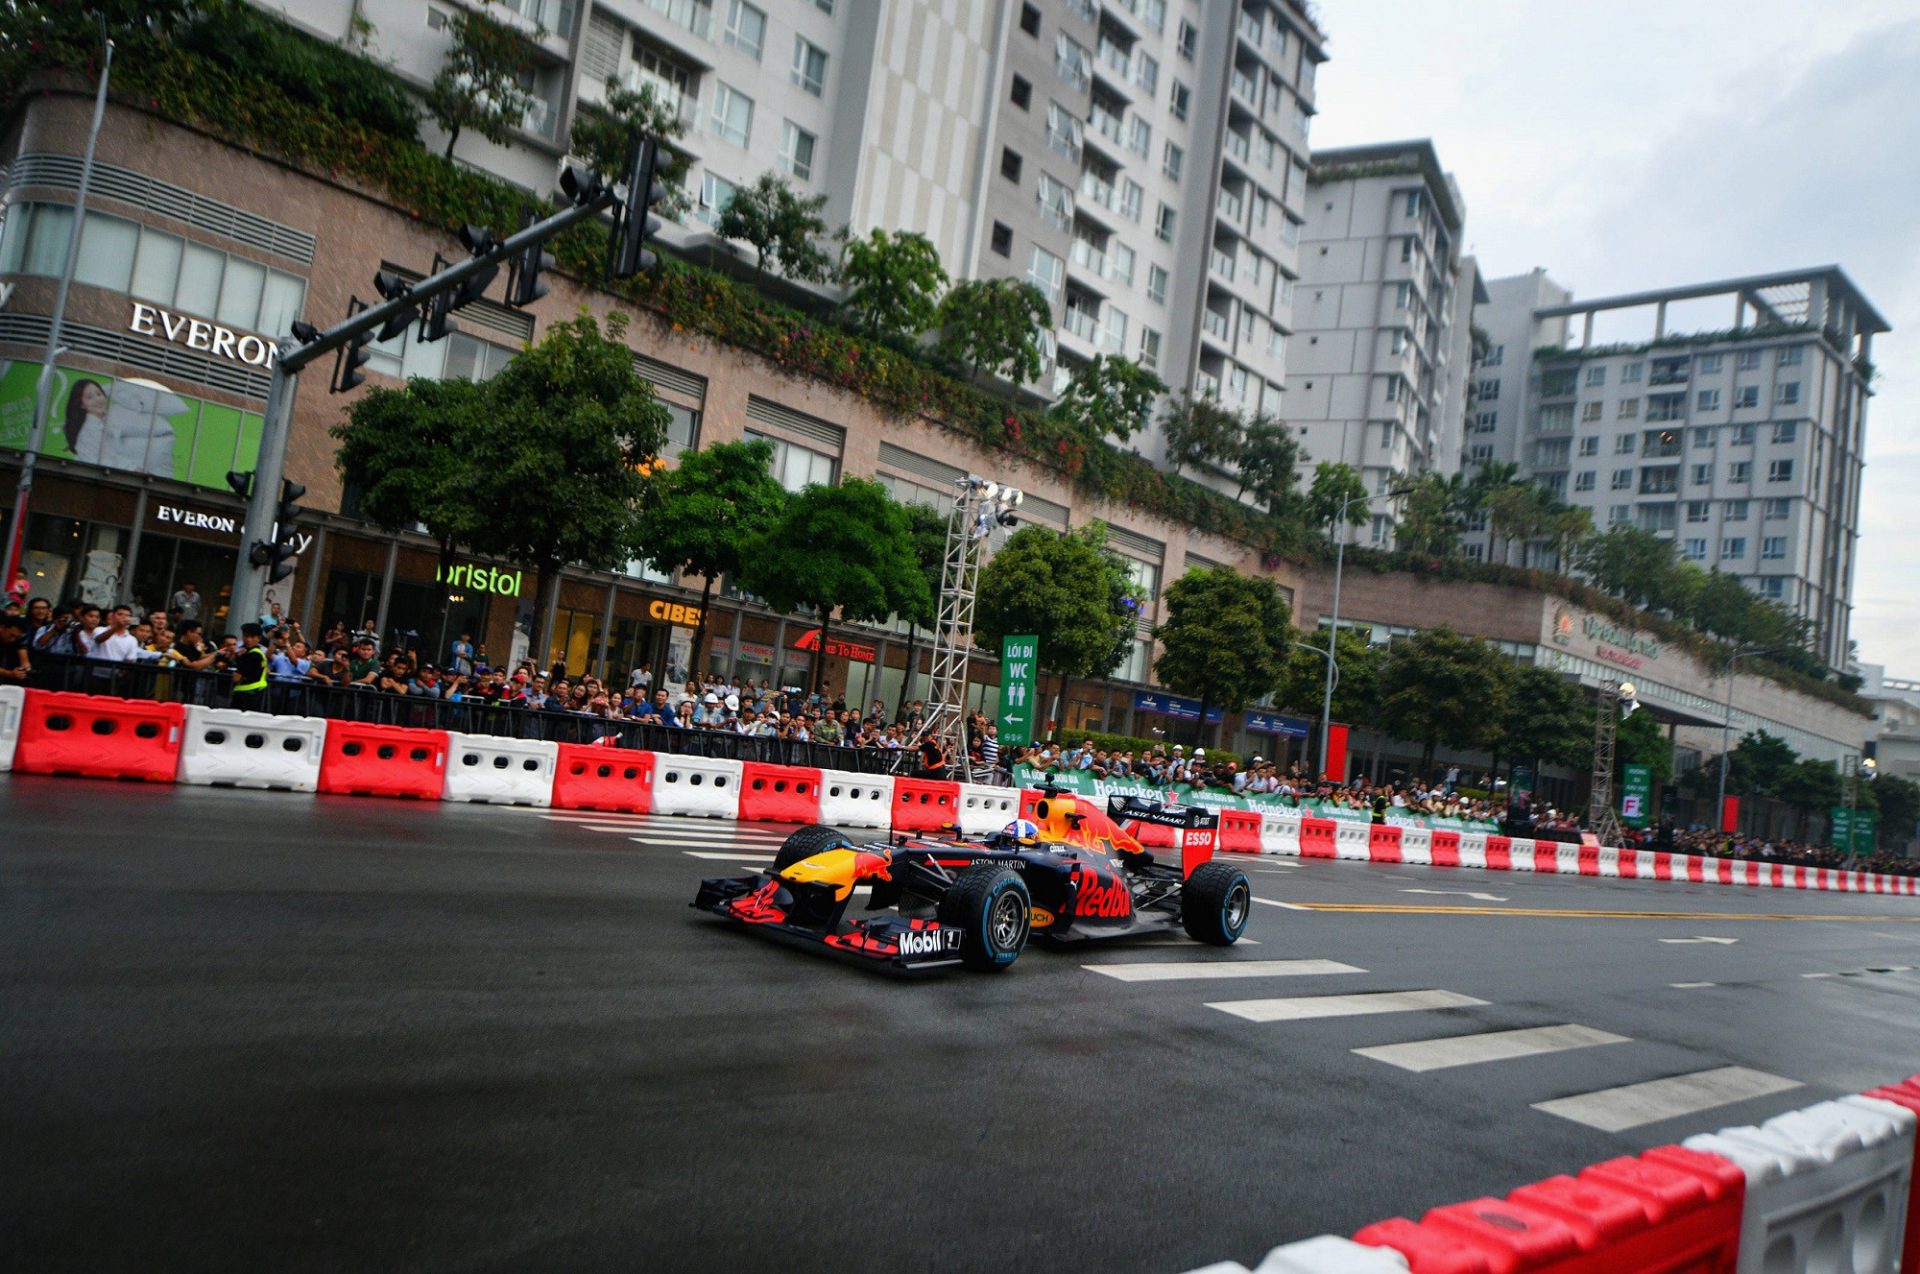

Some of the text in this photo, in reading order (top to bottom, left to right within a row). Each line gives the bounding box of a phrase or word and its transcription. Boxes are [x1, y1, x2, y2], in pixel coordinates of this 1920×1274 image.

[157, 505, 235, 533] EVERON
[811, 639, 836, 654] HME
[1023, 645, 1032, 658] ĐI
[1010, 662, 1028, 678] WC
[1092, 778, 1164, 803] Heineken
[1247, 798, 1303, 818] Heineken
[1186, 832, 1212, 846] ESSO
[900, 929, 941, 955] Mobil
